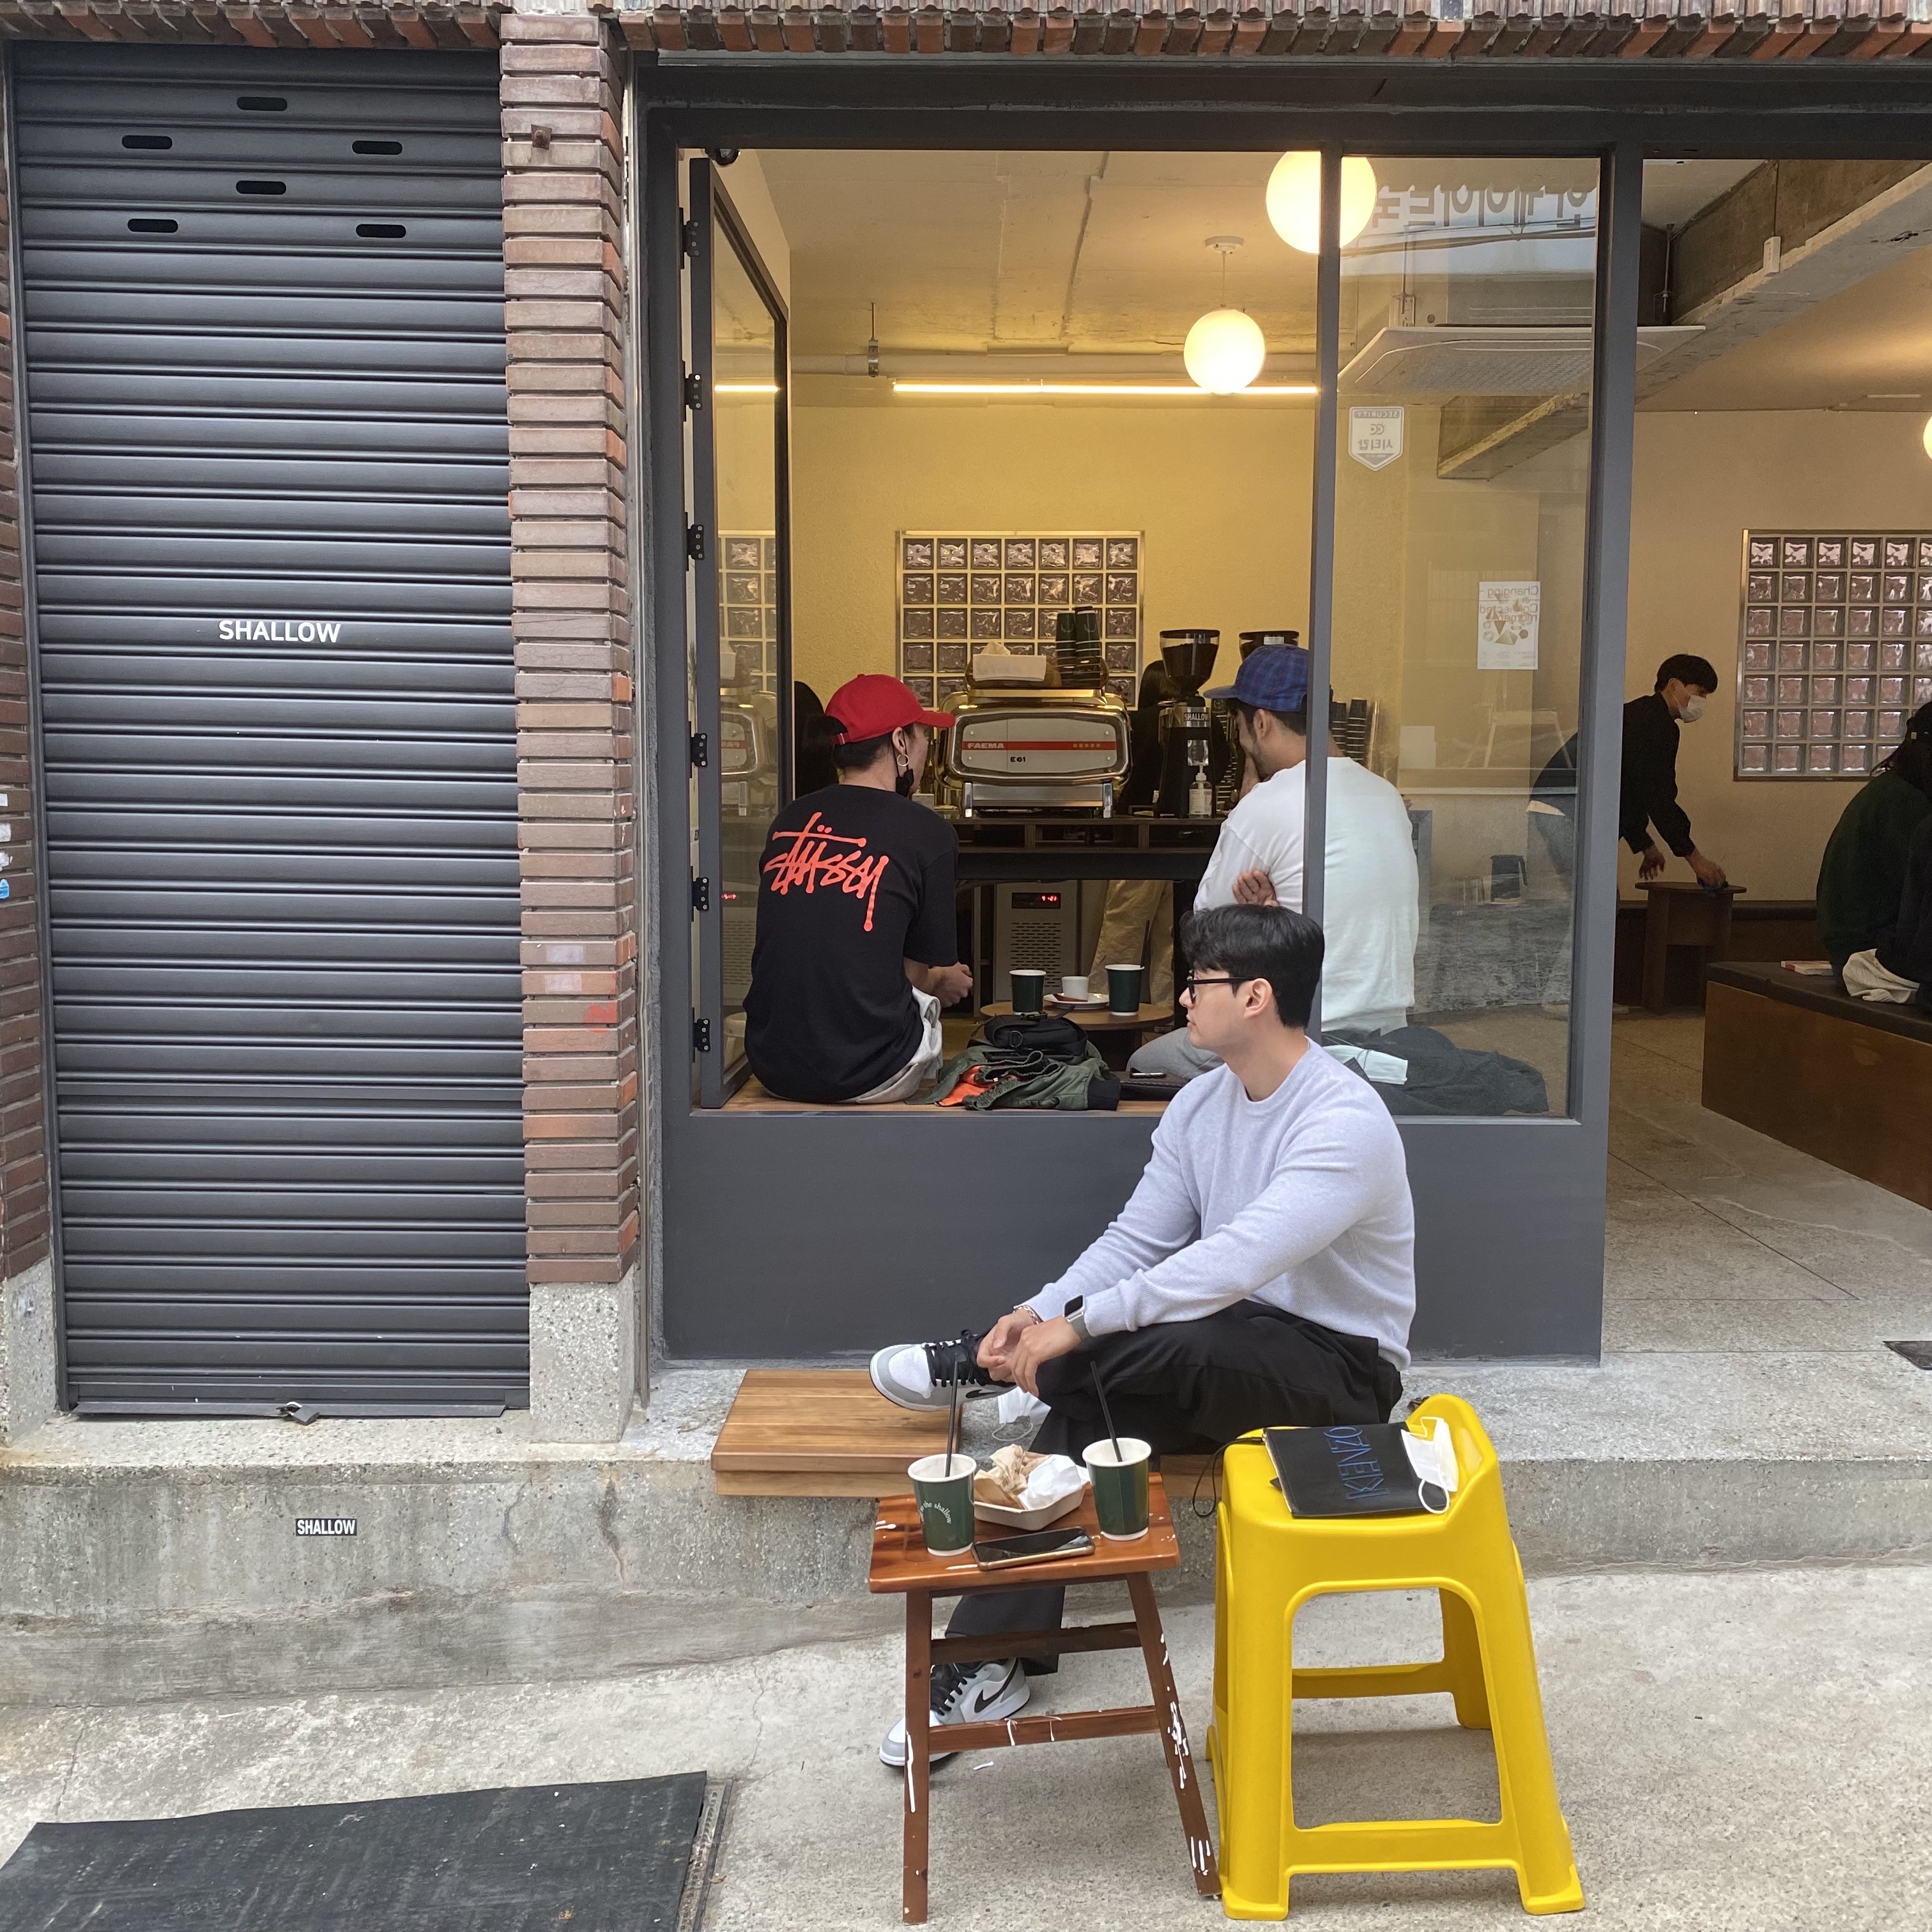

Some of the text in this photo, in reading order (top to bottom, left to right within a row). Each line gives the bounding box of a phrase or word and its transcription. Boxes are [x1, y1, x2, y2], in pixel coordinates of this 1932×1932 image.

[218, 620, 342, 643] SHALLOW
[1324, 1427, 1389, 1499] KENZO
[934, 1503, 951, 1524] shallow
[297, 1520, 355, 1535] SHALLOW
